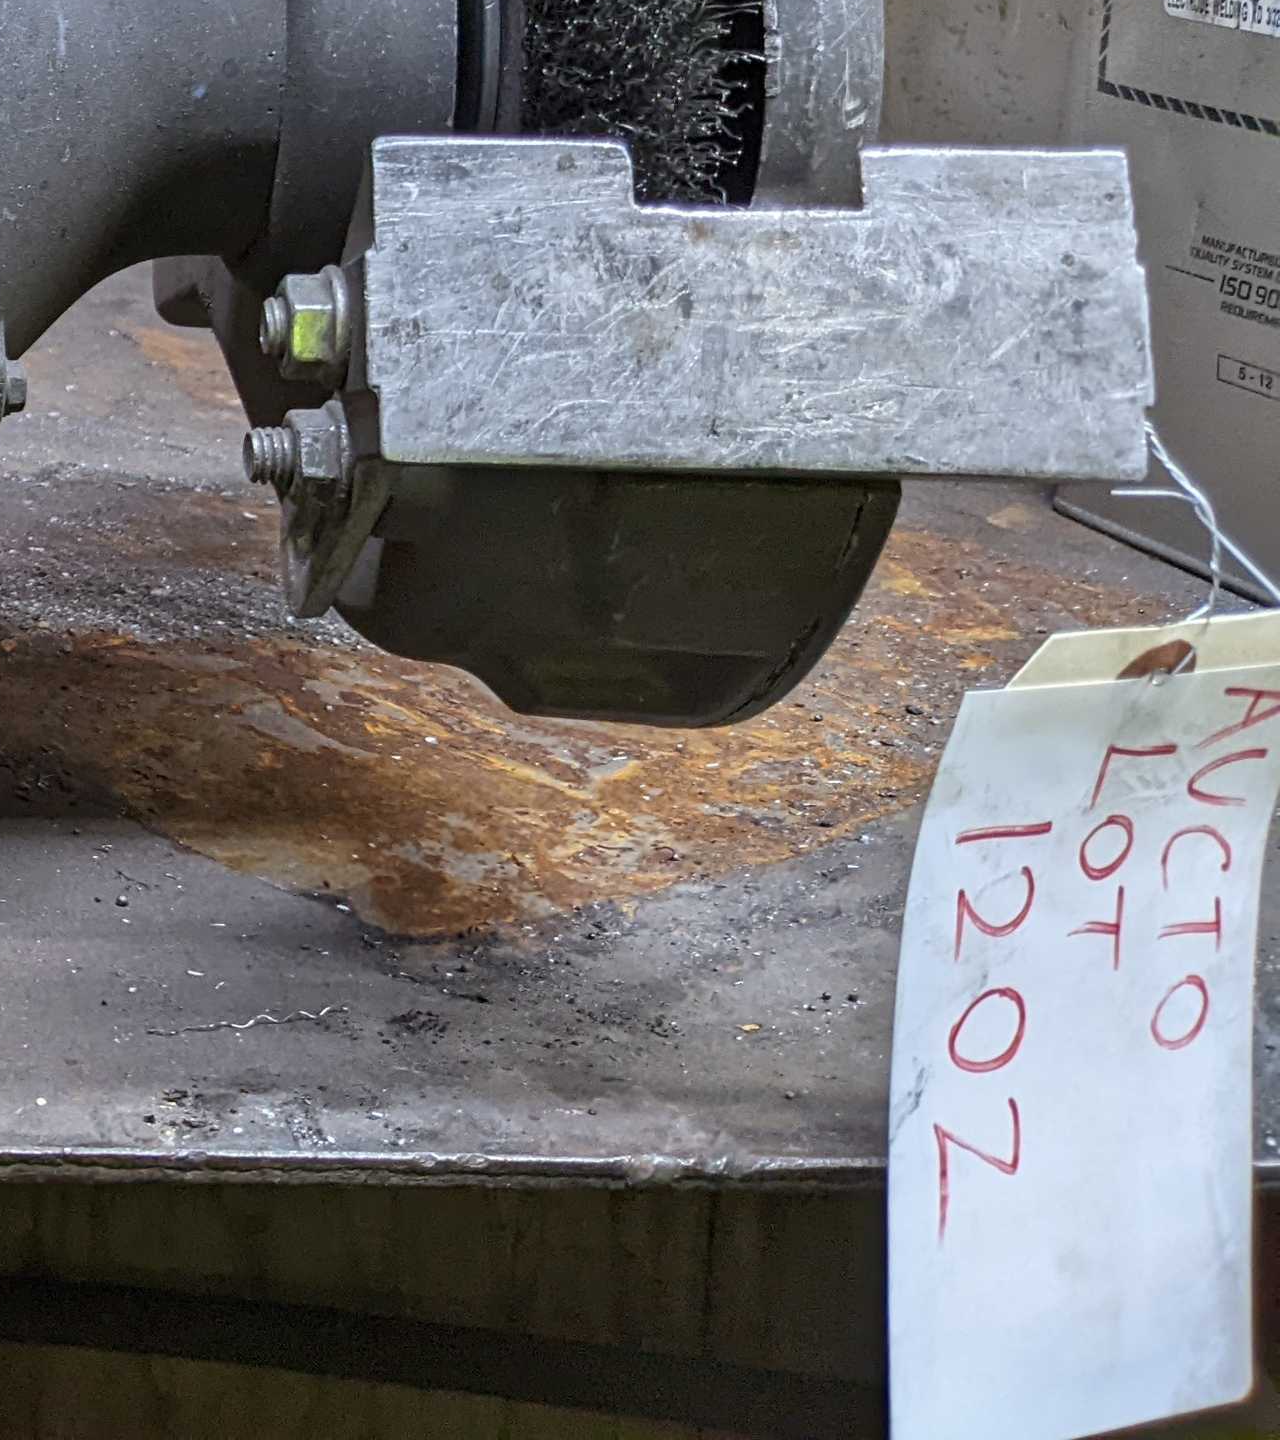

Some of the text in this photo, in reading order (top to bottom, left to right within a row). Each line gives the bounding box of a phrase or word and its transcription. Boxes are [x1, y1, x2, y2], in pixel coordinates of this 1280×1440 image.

[1231, 260, 1274, 280] SYSTEM
[1220, 274, 1252, 300] ISO
[1066, 741, 1179, 972] LOT
